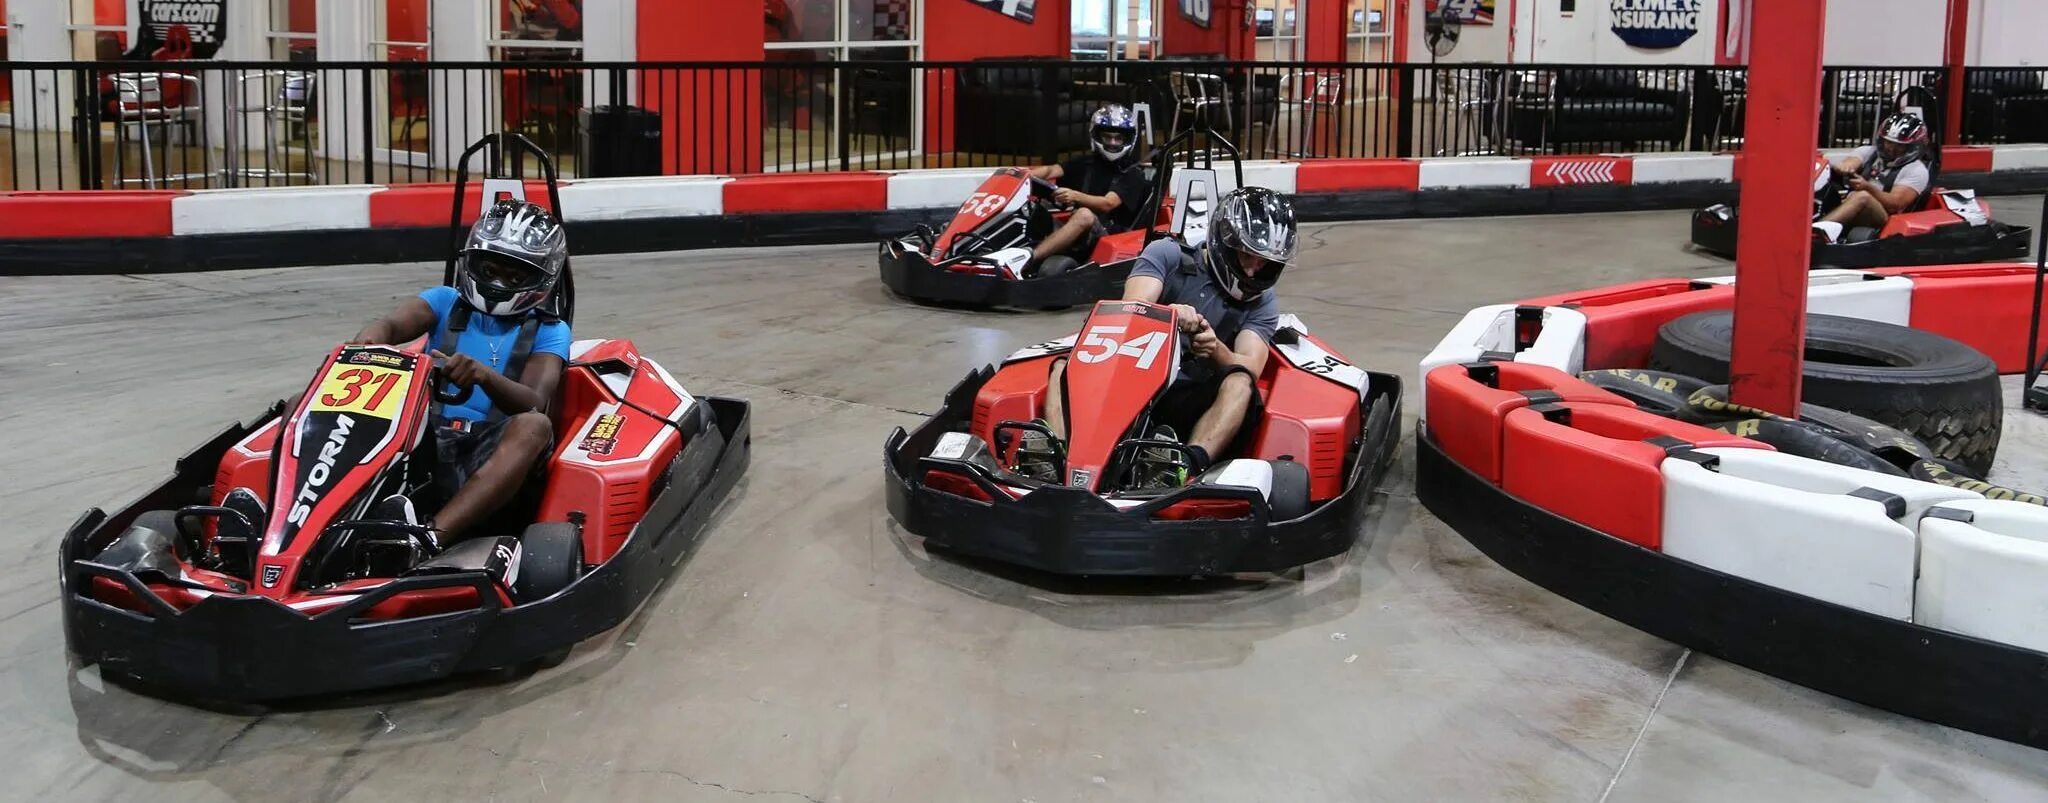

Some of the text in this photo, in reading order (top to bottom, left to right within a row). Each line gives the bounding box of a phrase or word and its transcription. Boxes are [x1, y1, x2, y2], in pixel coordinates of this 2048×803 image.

[151, 2, 220, 23] cars.com
[959, 192, 1007, 218] 58
[1077, 326, 1169, 370] 54
[1301, 355, 1350, 374] 54
[321, 368, 402, 412] 31
[287, 413, 356, 528] STORM
